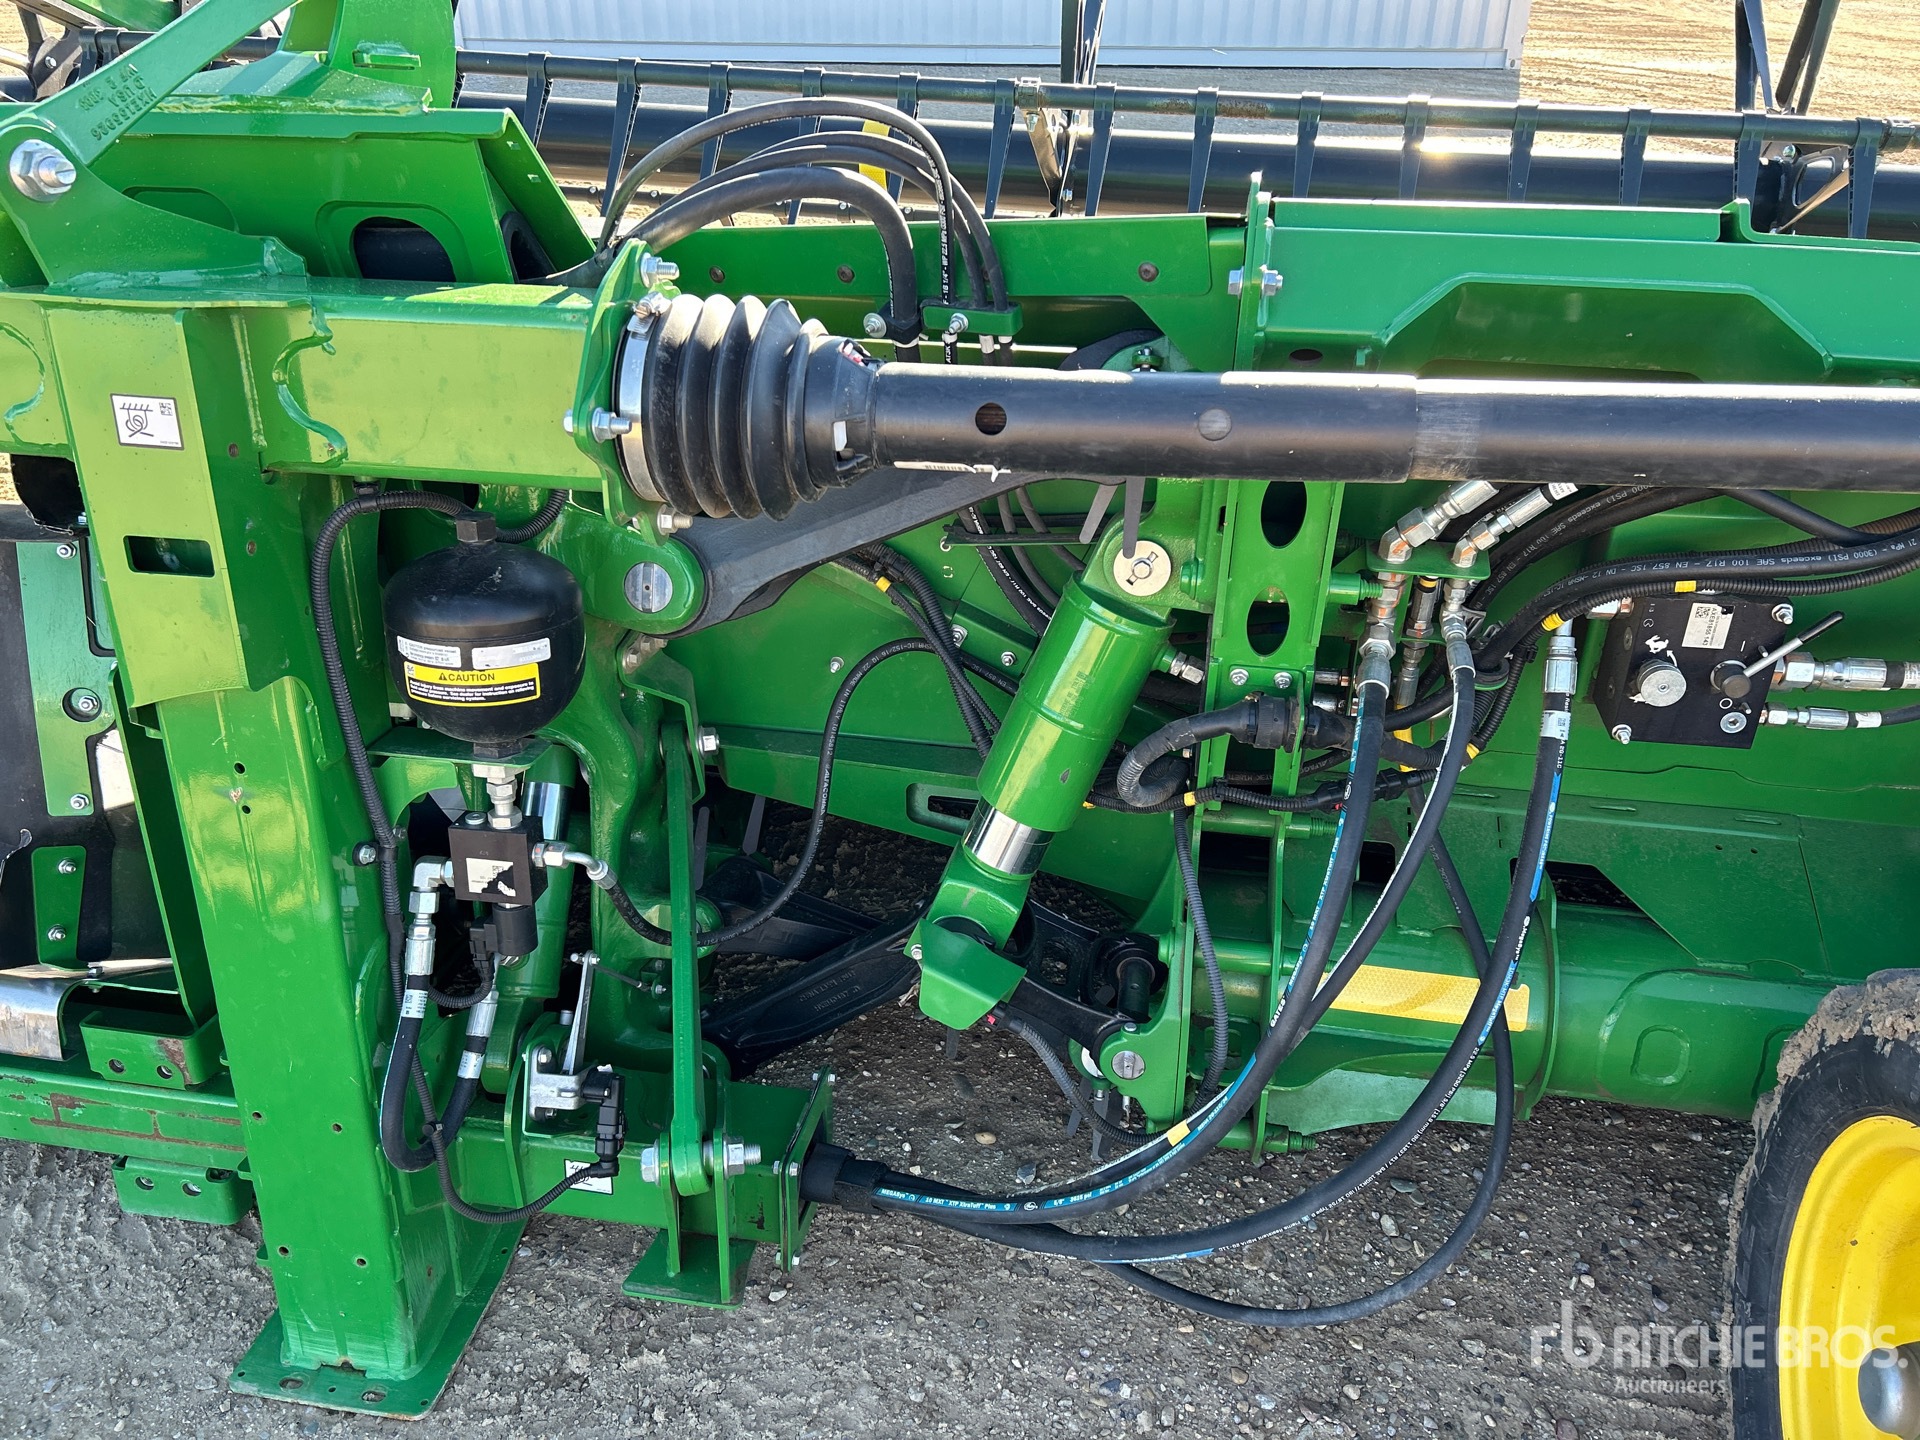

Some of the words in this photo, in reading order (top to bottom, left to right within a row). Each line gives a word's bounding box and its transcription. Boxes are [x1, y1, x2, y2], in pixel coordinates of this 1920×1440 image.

[1604, 490, 1627, 504] PSI)
[1566, 501, 1601, 523] exceeds
[1550, 521, 1565, 535] SAE
[1907, 537, 1916, 546] 21
[1521, 542, 1536, 557] R17
[1853, 548, 1877, 558] (3000
[1780, 554, 1821, 564] exceeds
[1827, 552, 1848, 561] PSI)
[1629, 563, 1646, 572] 1SC
[862, 662, 870, 671] 22
[448, 673, 495, 682] CAUTION
[849, 670, 864, 686] MADE
[843, 687, 852, 697] IN
[834, 699, 846, 719] ITALY
[1268, 998, 1286, 1028] GATES
[1417, 1120, 1430, 1134] mm)
